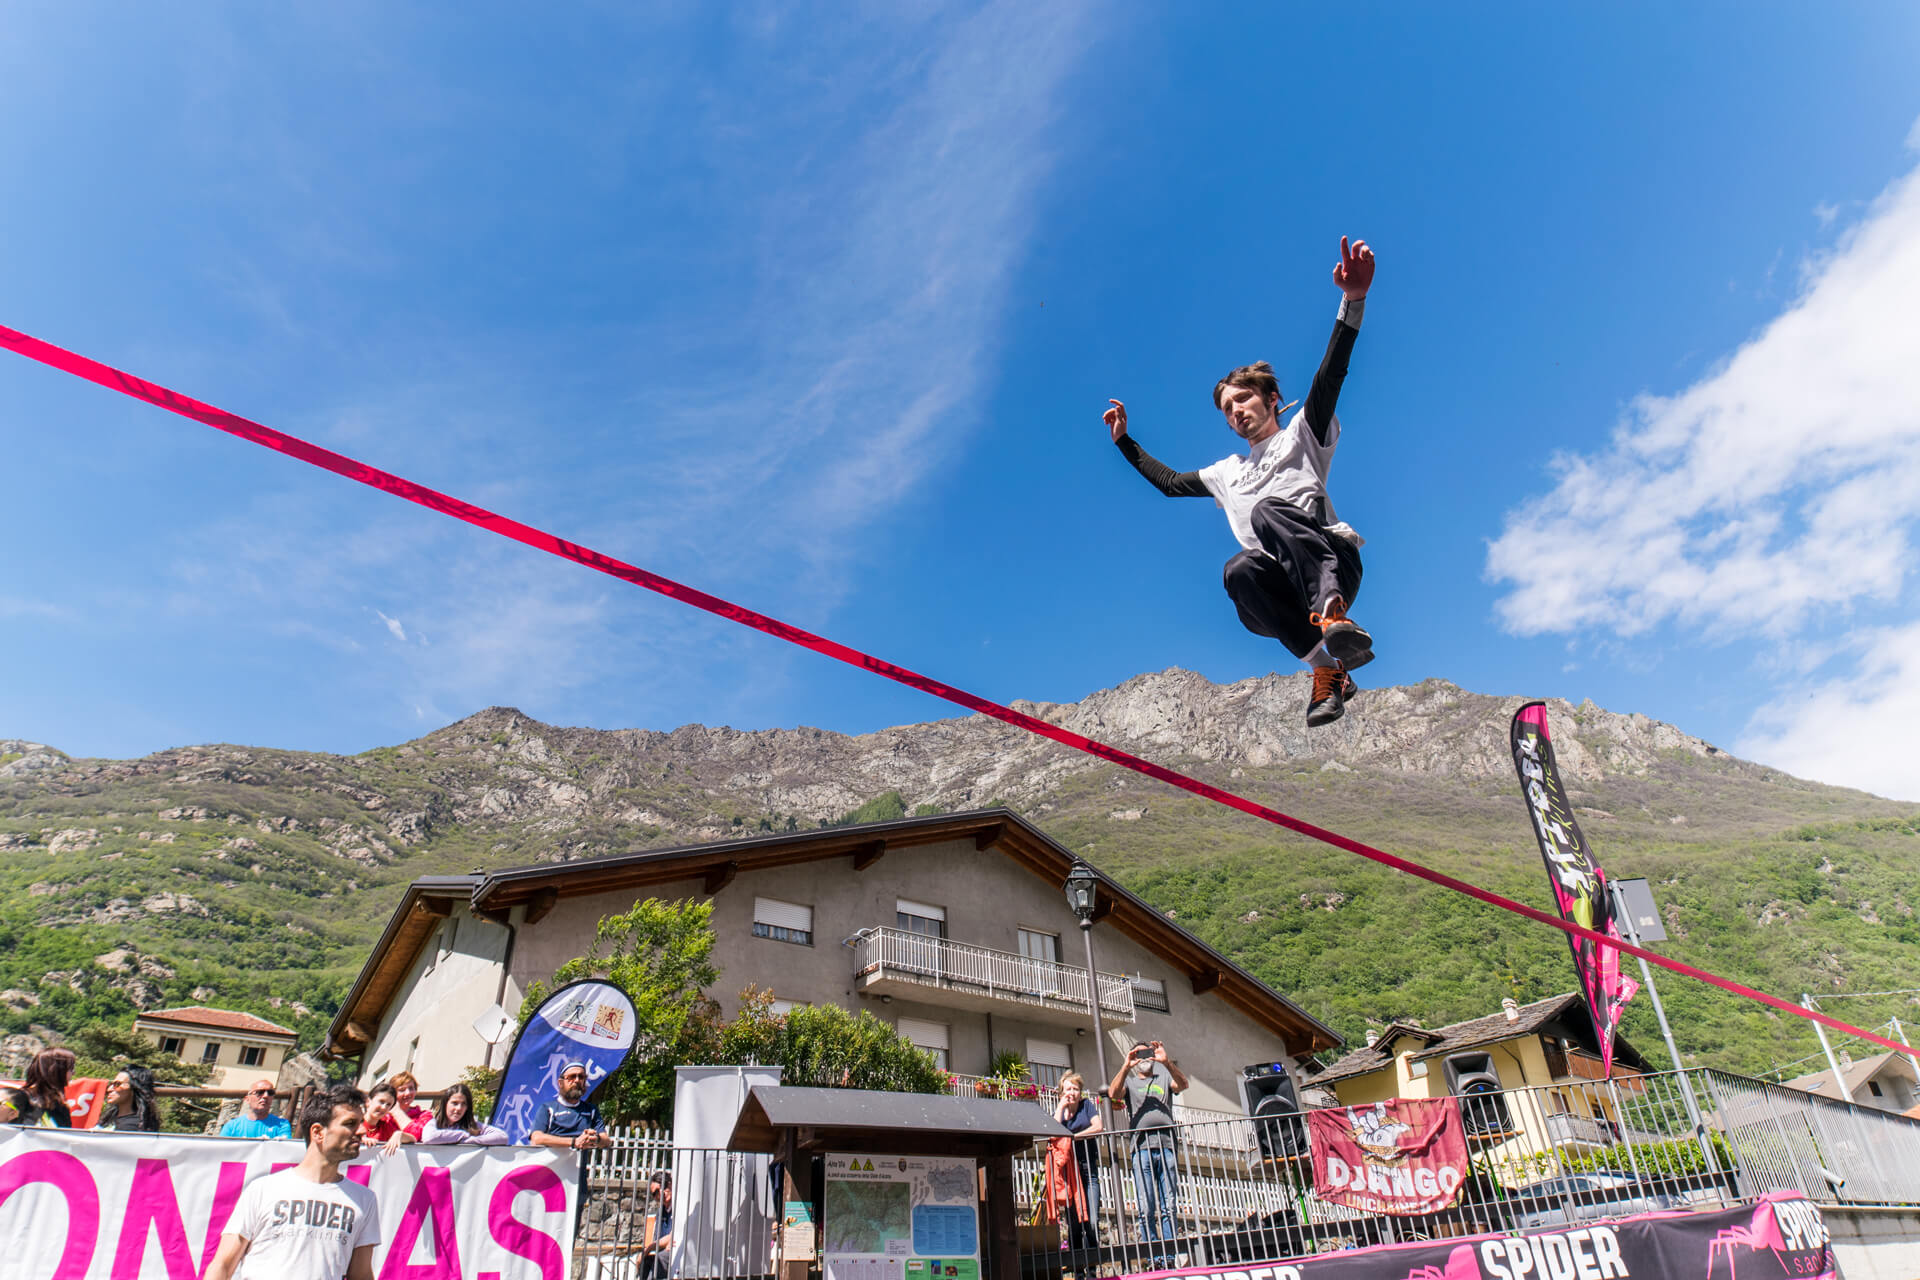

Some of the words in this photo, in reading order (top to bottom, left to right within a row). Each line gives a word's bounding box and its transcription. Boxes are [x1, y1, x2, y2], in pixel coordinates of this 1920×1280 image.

[1327, 1157, 1460, 1198] DJANGO
[0, 1150, 567, 1280] ONAS
[272, 1199, 356, 1234] SPIDER
[1481, 1226, 1630, 1280] SPIDER
